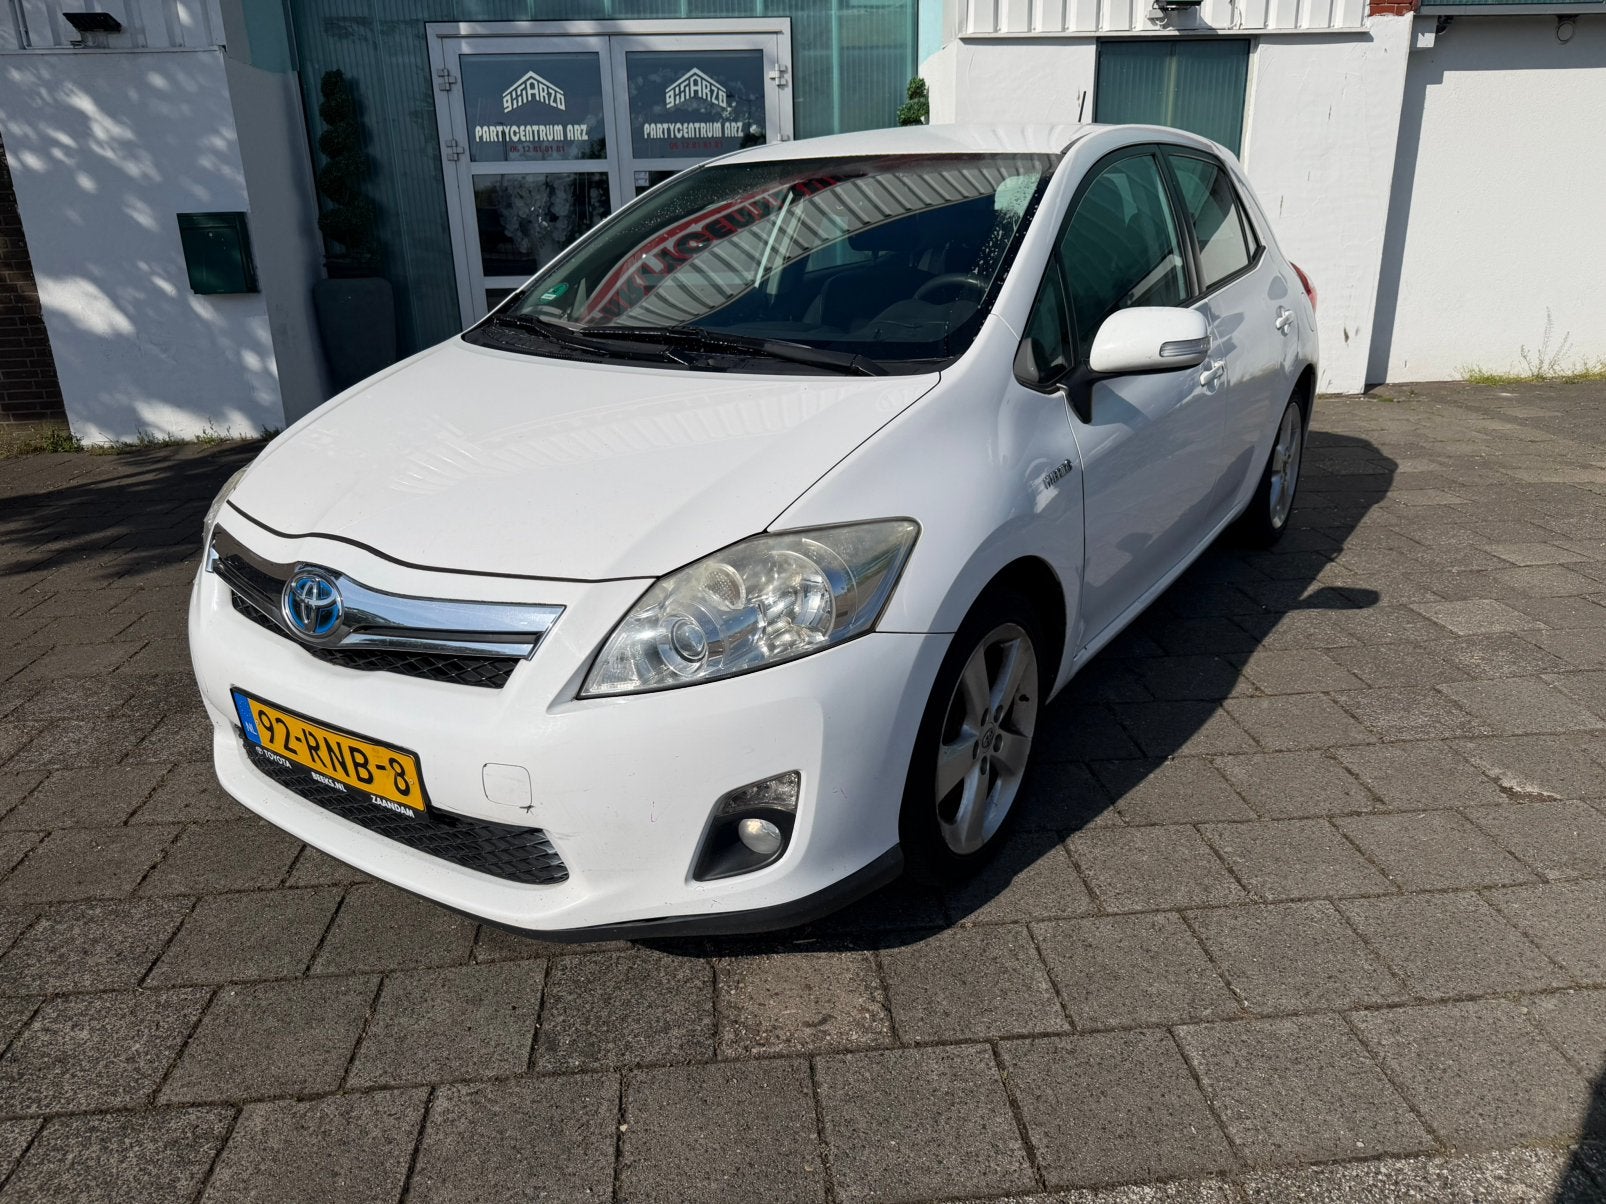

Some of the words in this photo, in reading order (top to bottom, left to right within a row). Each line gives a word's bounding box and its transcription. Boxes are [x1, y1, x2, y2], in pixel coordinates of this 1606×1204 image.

[475, 125, 564, 142] PARTYCENTRUM
[566, 124, 588, 140] ARZ
[644, 122, 722, 139] PARTYCENTRUM
[724, 122, 744, 137] ARZ
[245, 721, 257, 736] NL
[258, 709, 411, 797] 92-RNB-8
[263, 750, 293, 769] TOYOTA
[311, 771, 348, 793] BEEKS.NL
[370, 794, 416, 819] ZAANDAM
